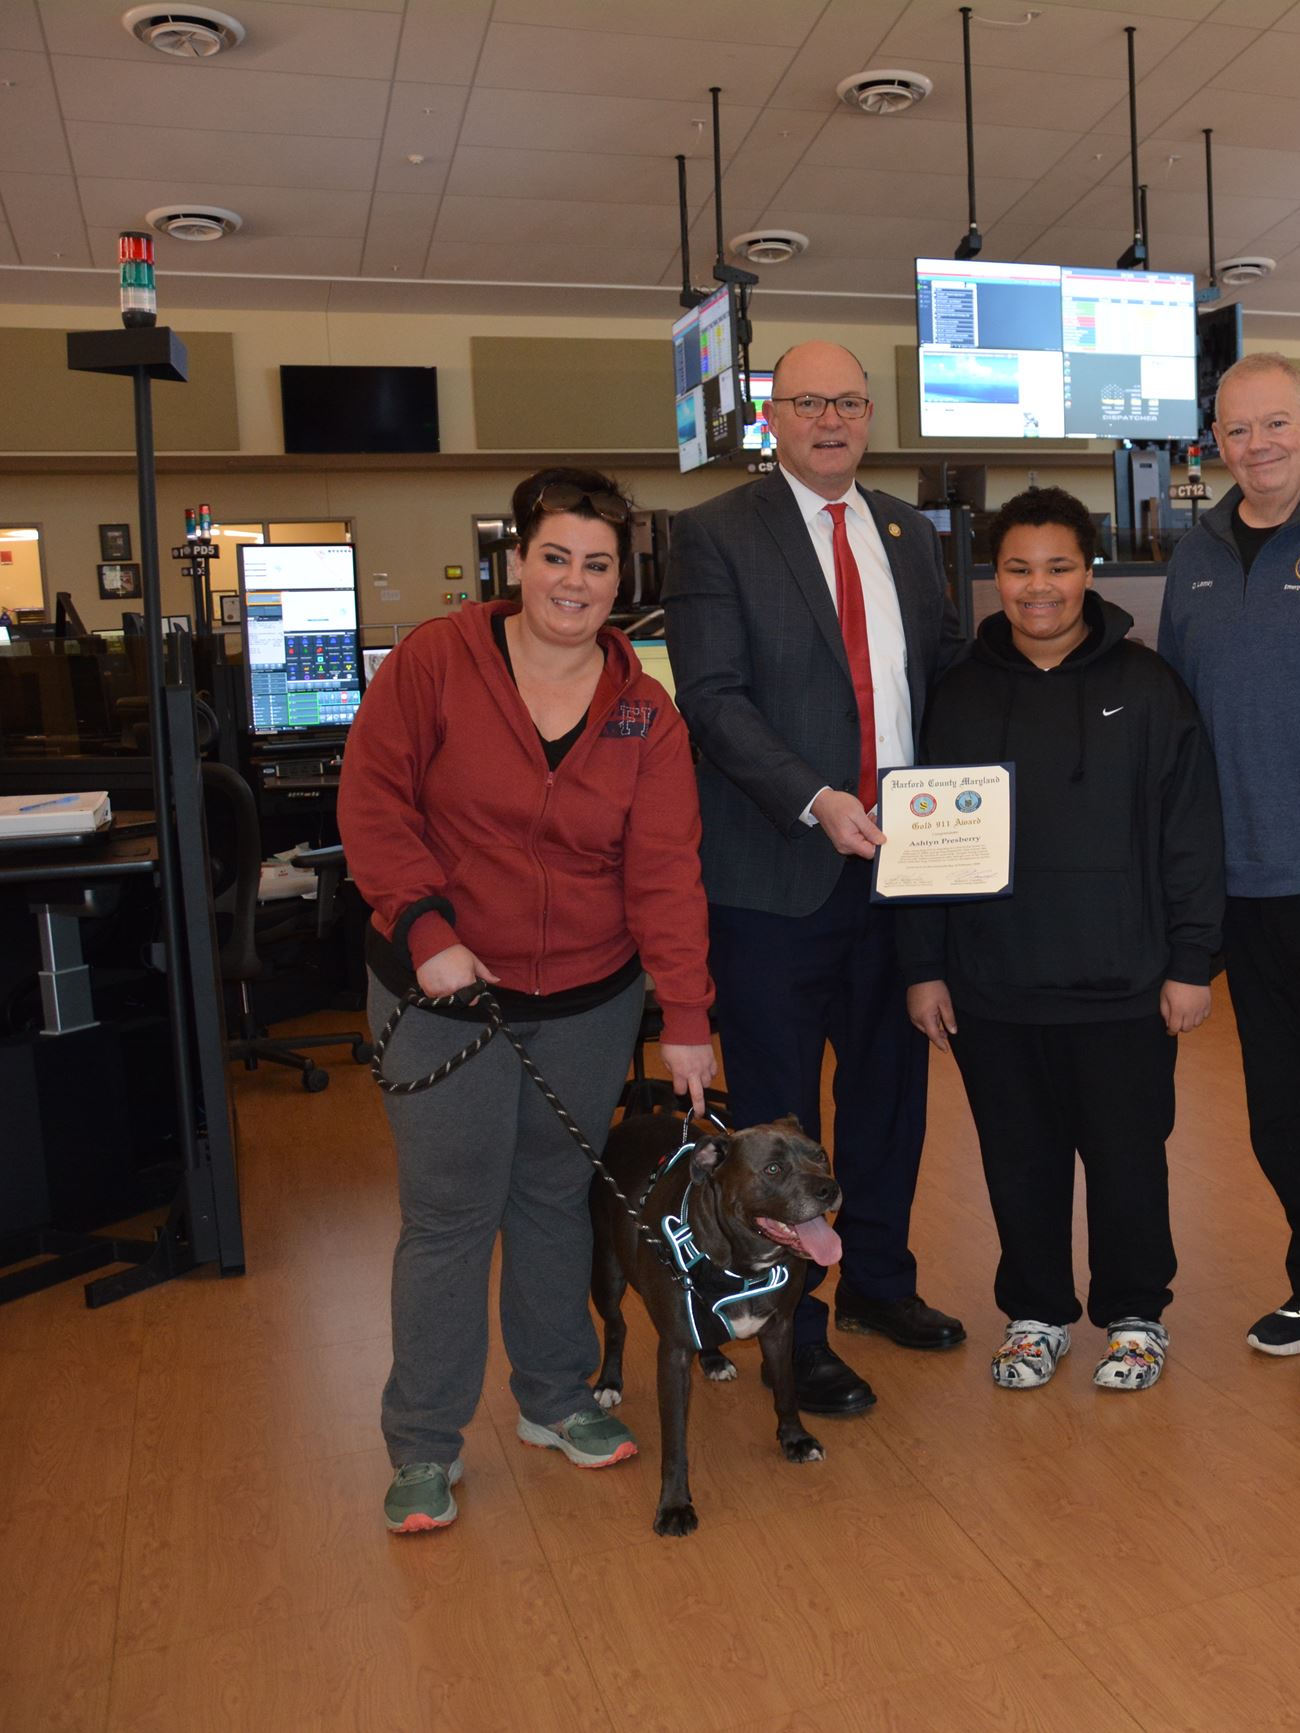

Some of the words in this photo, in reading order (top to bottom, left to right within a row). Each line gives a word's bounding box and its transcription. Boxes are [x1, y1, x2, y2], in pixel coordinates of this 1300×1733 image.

[758, 461, 777, 472] CS
[1178, 484, 1205, 497] CT12
[193, 545, 215, 555] PD5
[891, 779, 924, 790] Harford
[928, 779, 957, 789] County
[960, 776, 1000, 786] Maryland
[911, 822, 932, 830] Gold
[936, 820, 950, 828] 911
[953, 817, 981, 829] Award
[941, 836, 980, 845] Presberry
